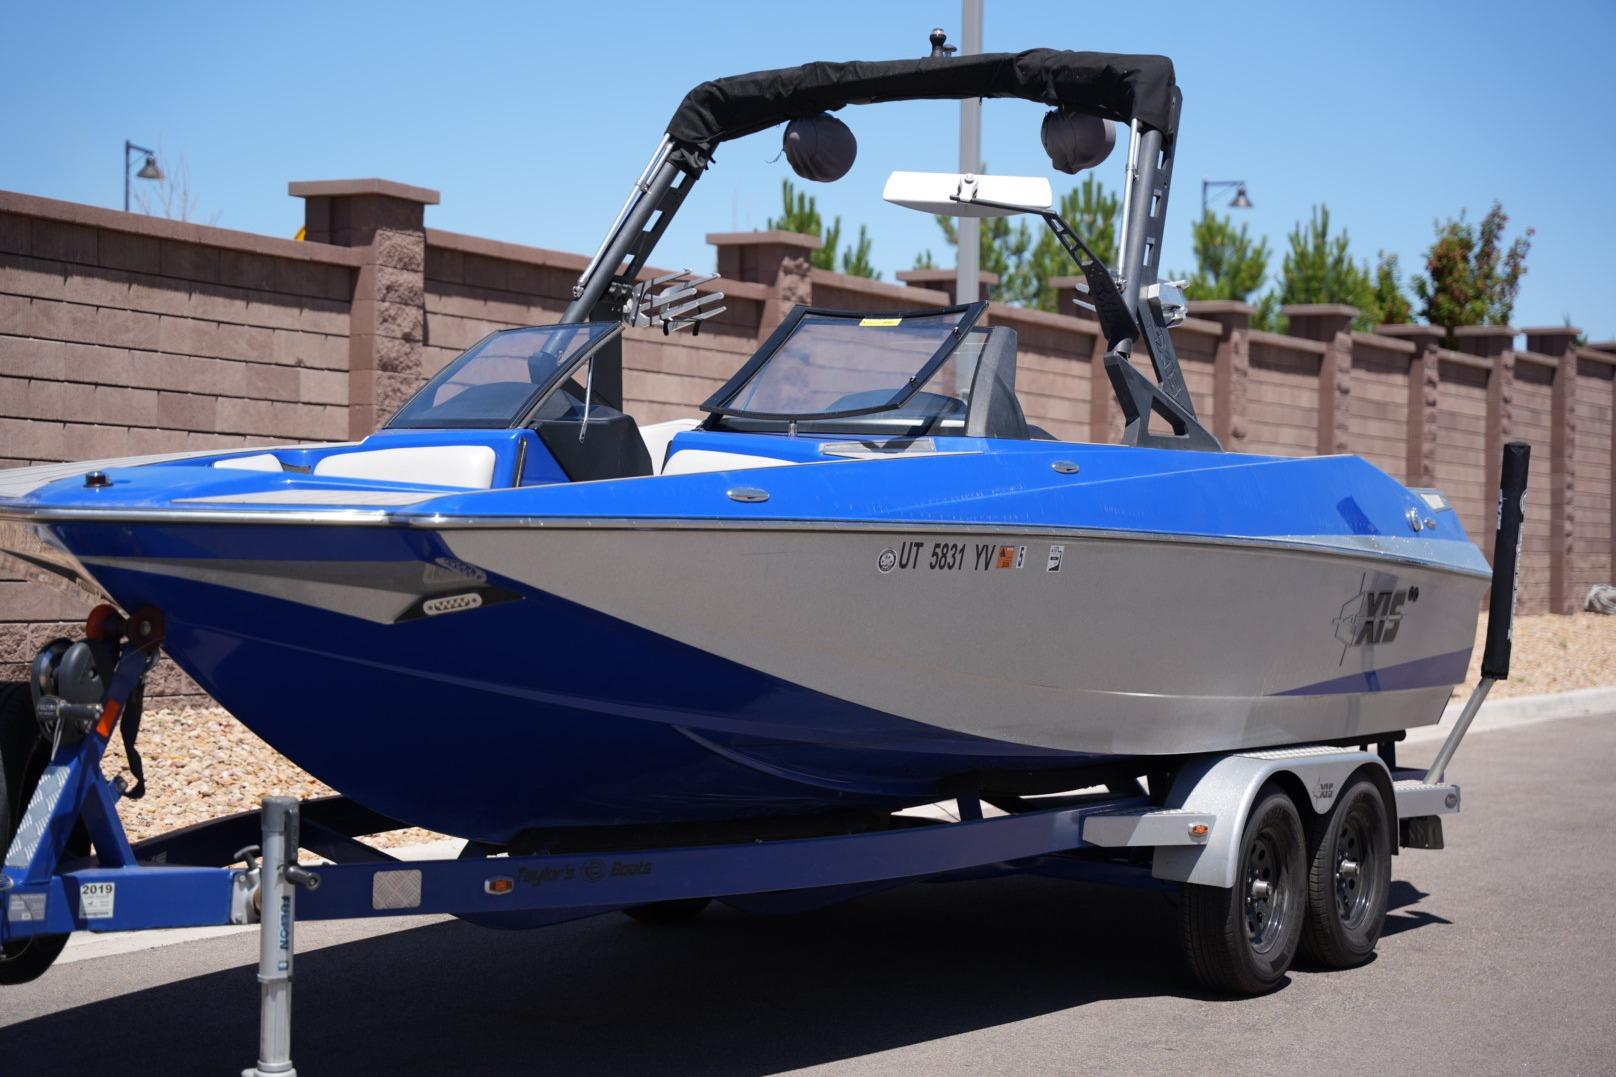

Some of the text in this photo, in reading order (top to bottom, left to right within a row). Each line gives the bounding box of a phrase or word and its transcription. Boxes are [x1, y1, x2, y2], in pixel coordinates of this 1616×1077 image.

[900, 541, 924, 569] UT
[930, 543, 966, 570] 5831
[974, 544, 996, 571] YV
[82, 884, 113, 895] 2019
